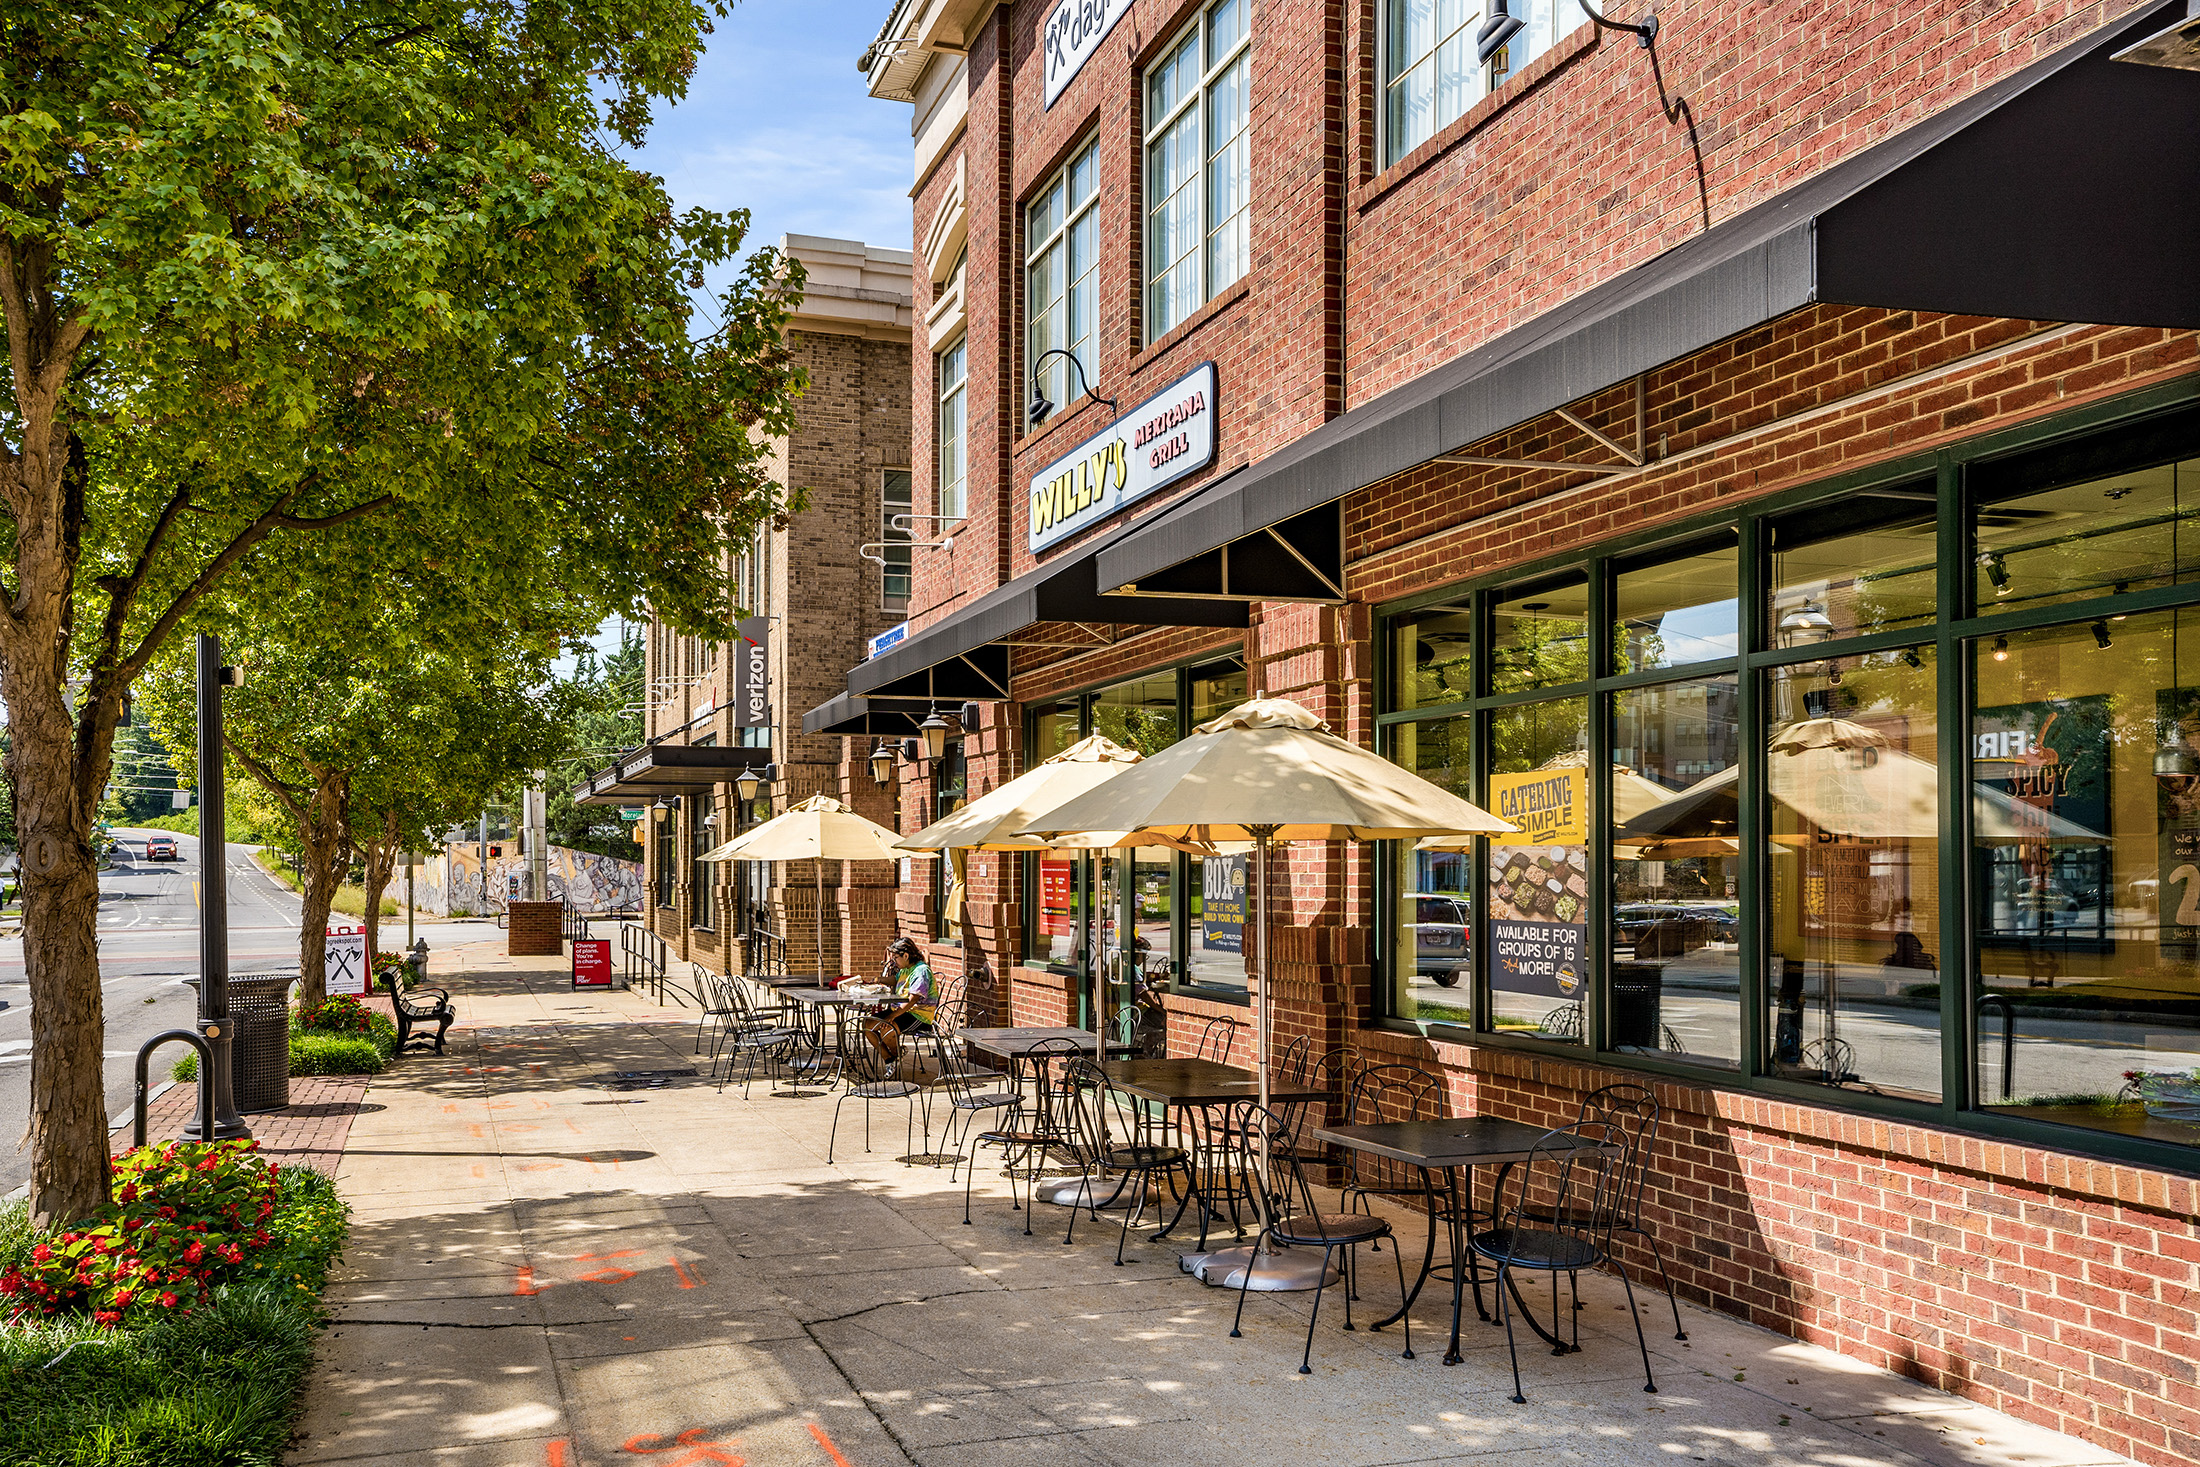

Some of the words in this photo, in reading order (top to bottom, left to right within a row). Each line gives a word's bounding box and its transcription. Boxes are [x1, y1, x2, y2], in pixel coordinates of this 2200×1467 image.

[1071, 0, 1110, 51] dag
[1134, 391, 1206, 449] MEXICANA
[1149, 432, 1189, 469] GRILL
[1032, 437, 1127, 535] WILLY'S
[746, 646, 764, 722] verizon
[2005, 764, 2072, 798] SPICY
[1501, 775, 1572, 818] CATERING
[1824, 794, 1865, 813] EVERY
[1516, 807, 1572, 834] SIMPLE
[2175, 834, 2192, 843] We
[2175, 847, 2193, 856] our
[1204, 858, 1233, 900] BOX
[1204, 912, 1217, 921] BUILD
[1218, 914, 1231, 923] YOUR
[1232, 915, 1244, 924] OWN
[1208, 902, 1218, 912] TAKE
[1219, 903, 1224, 912] IT
[1225, 903, 1240, 913] HOME
[1496, 925, 1549, 942] AVAILABLE
[1553, 928, 1577, 944] FOR
[2173, 929, 2193, 940] just
[1498, 941, 1541, 958] GROUPS
[1544, 944, 1560, 959] OF
[1563, 946, 1575, 961] 15
[1519, 961, 1554, 975] MORE!
